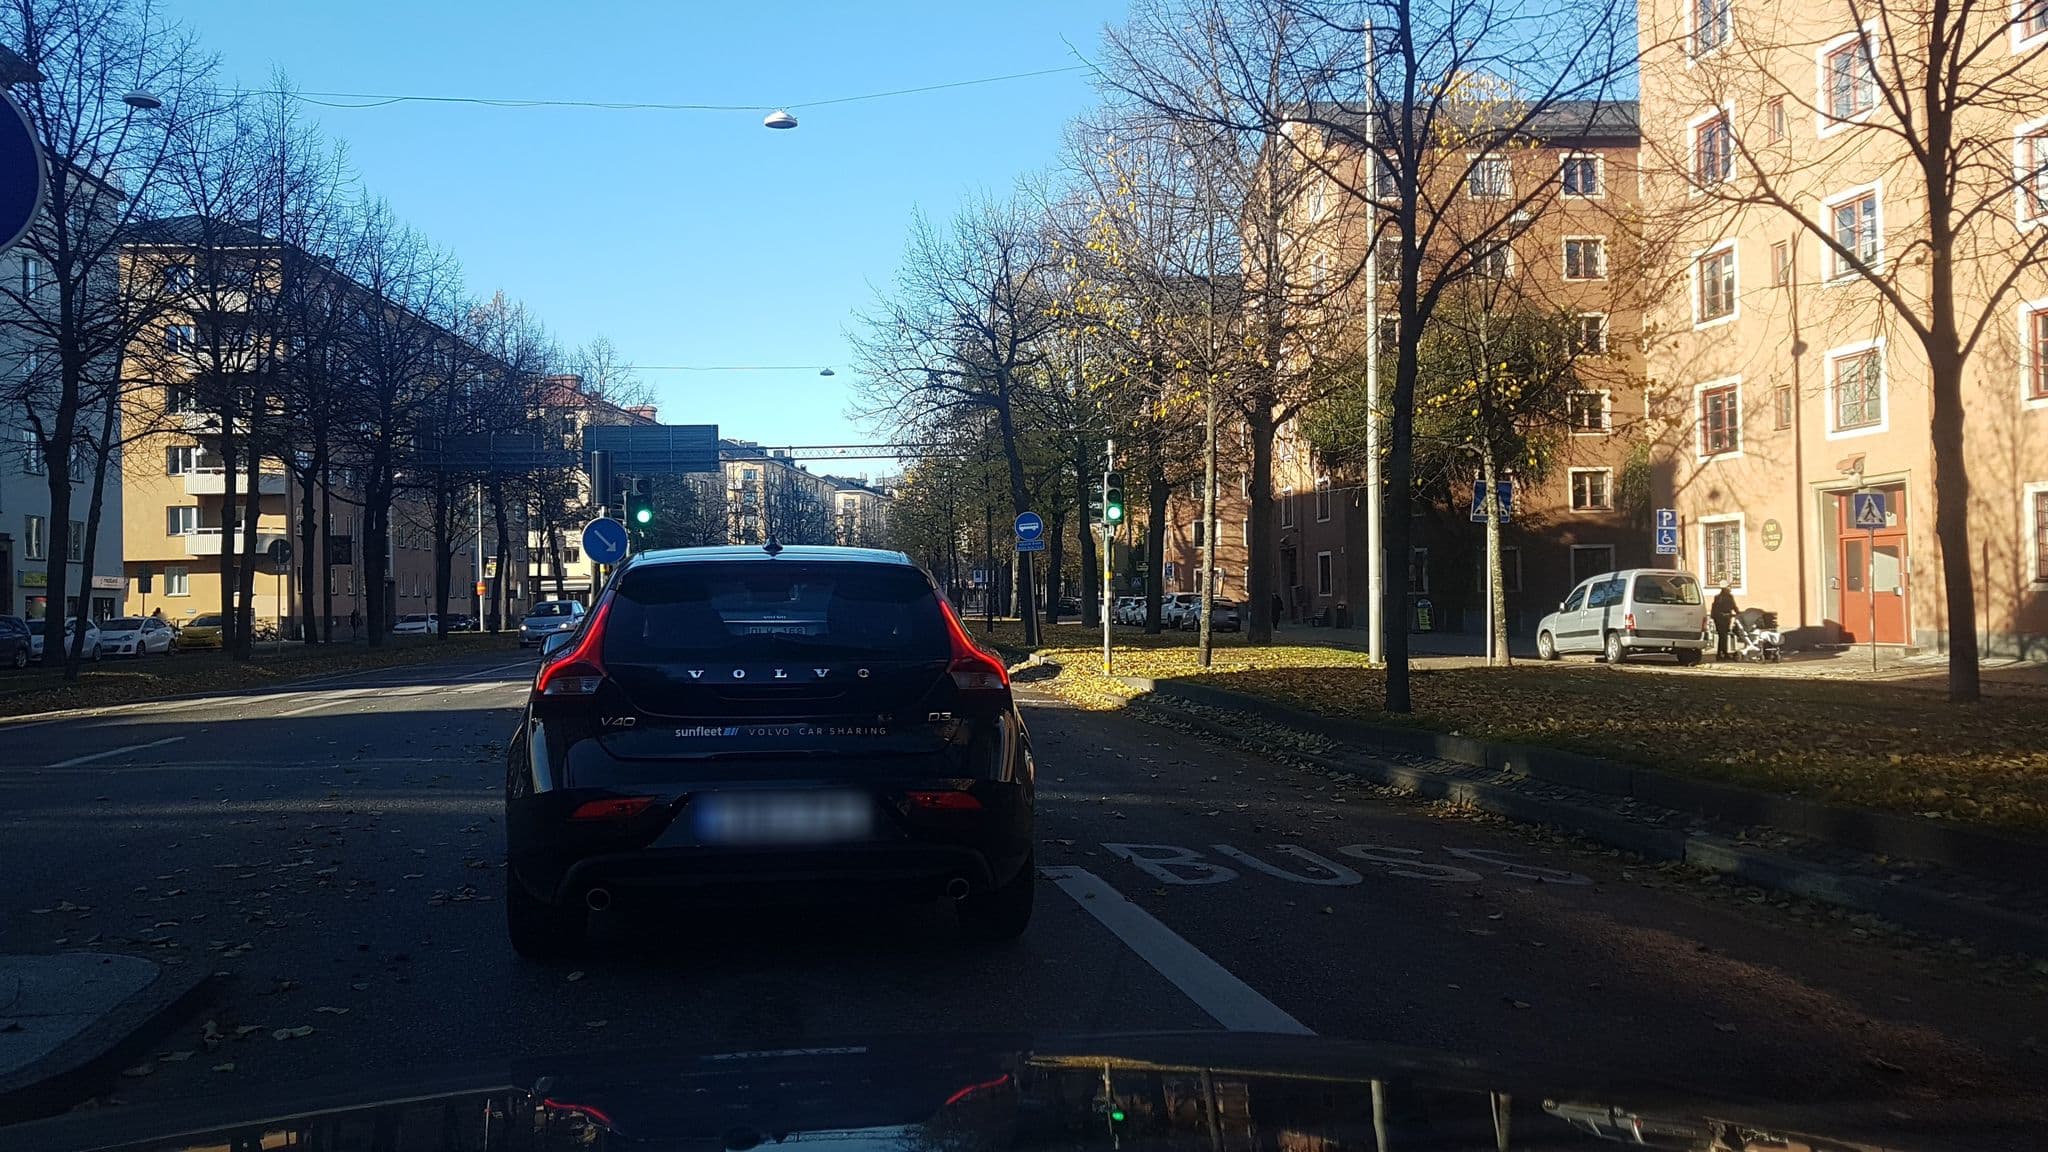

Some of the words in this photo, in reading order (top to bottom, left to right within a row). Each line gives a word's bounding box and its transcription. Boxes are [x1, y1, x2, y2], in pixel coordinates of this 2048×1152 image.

[1662, 511, 1673, 526] P
[687, 667, 871, 679] VOLVO
[600, 716, 636, 727] V40
[928, 711, 952, 722] D3
[675, 726, 722, 737] sunfleet
[748, 728, 790, 736] VOLVO
[799, 727, 823, 736] CAR
[829, 726, 887, 736] SHARING
[1098, 842, 1594, 886] BUSS
